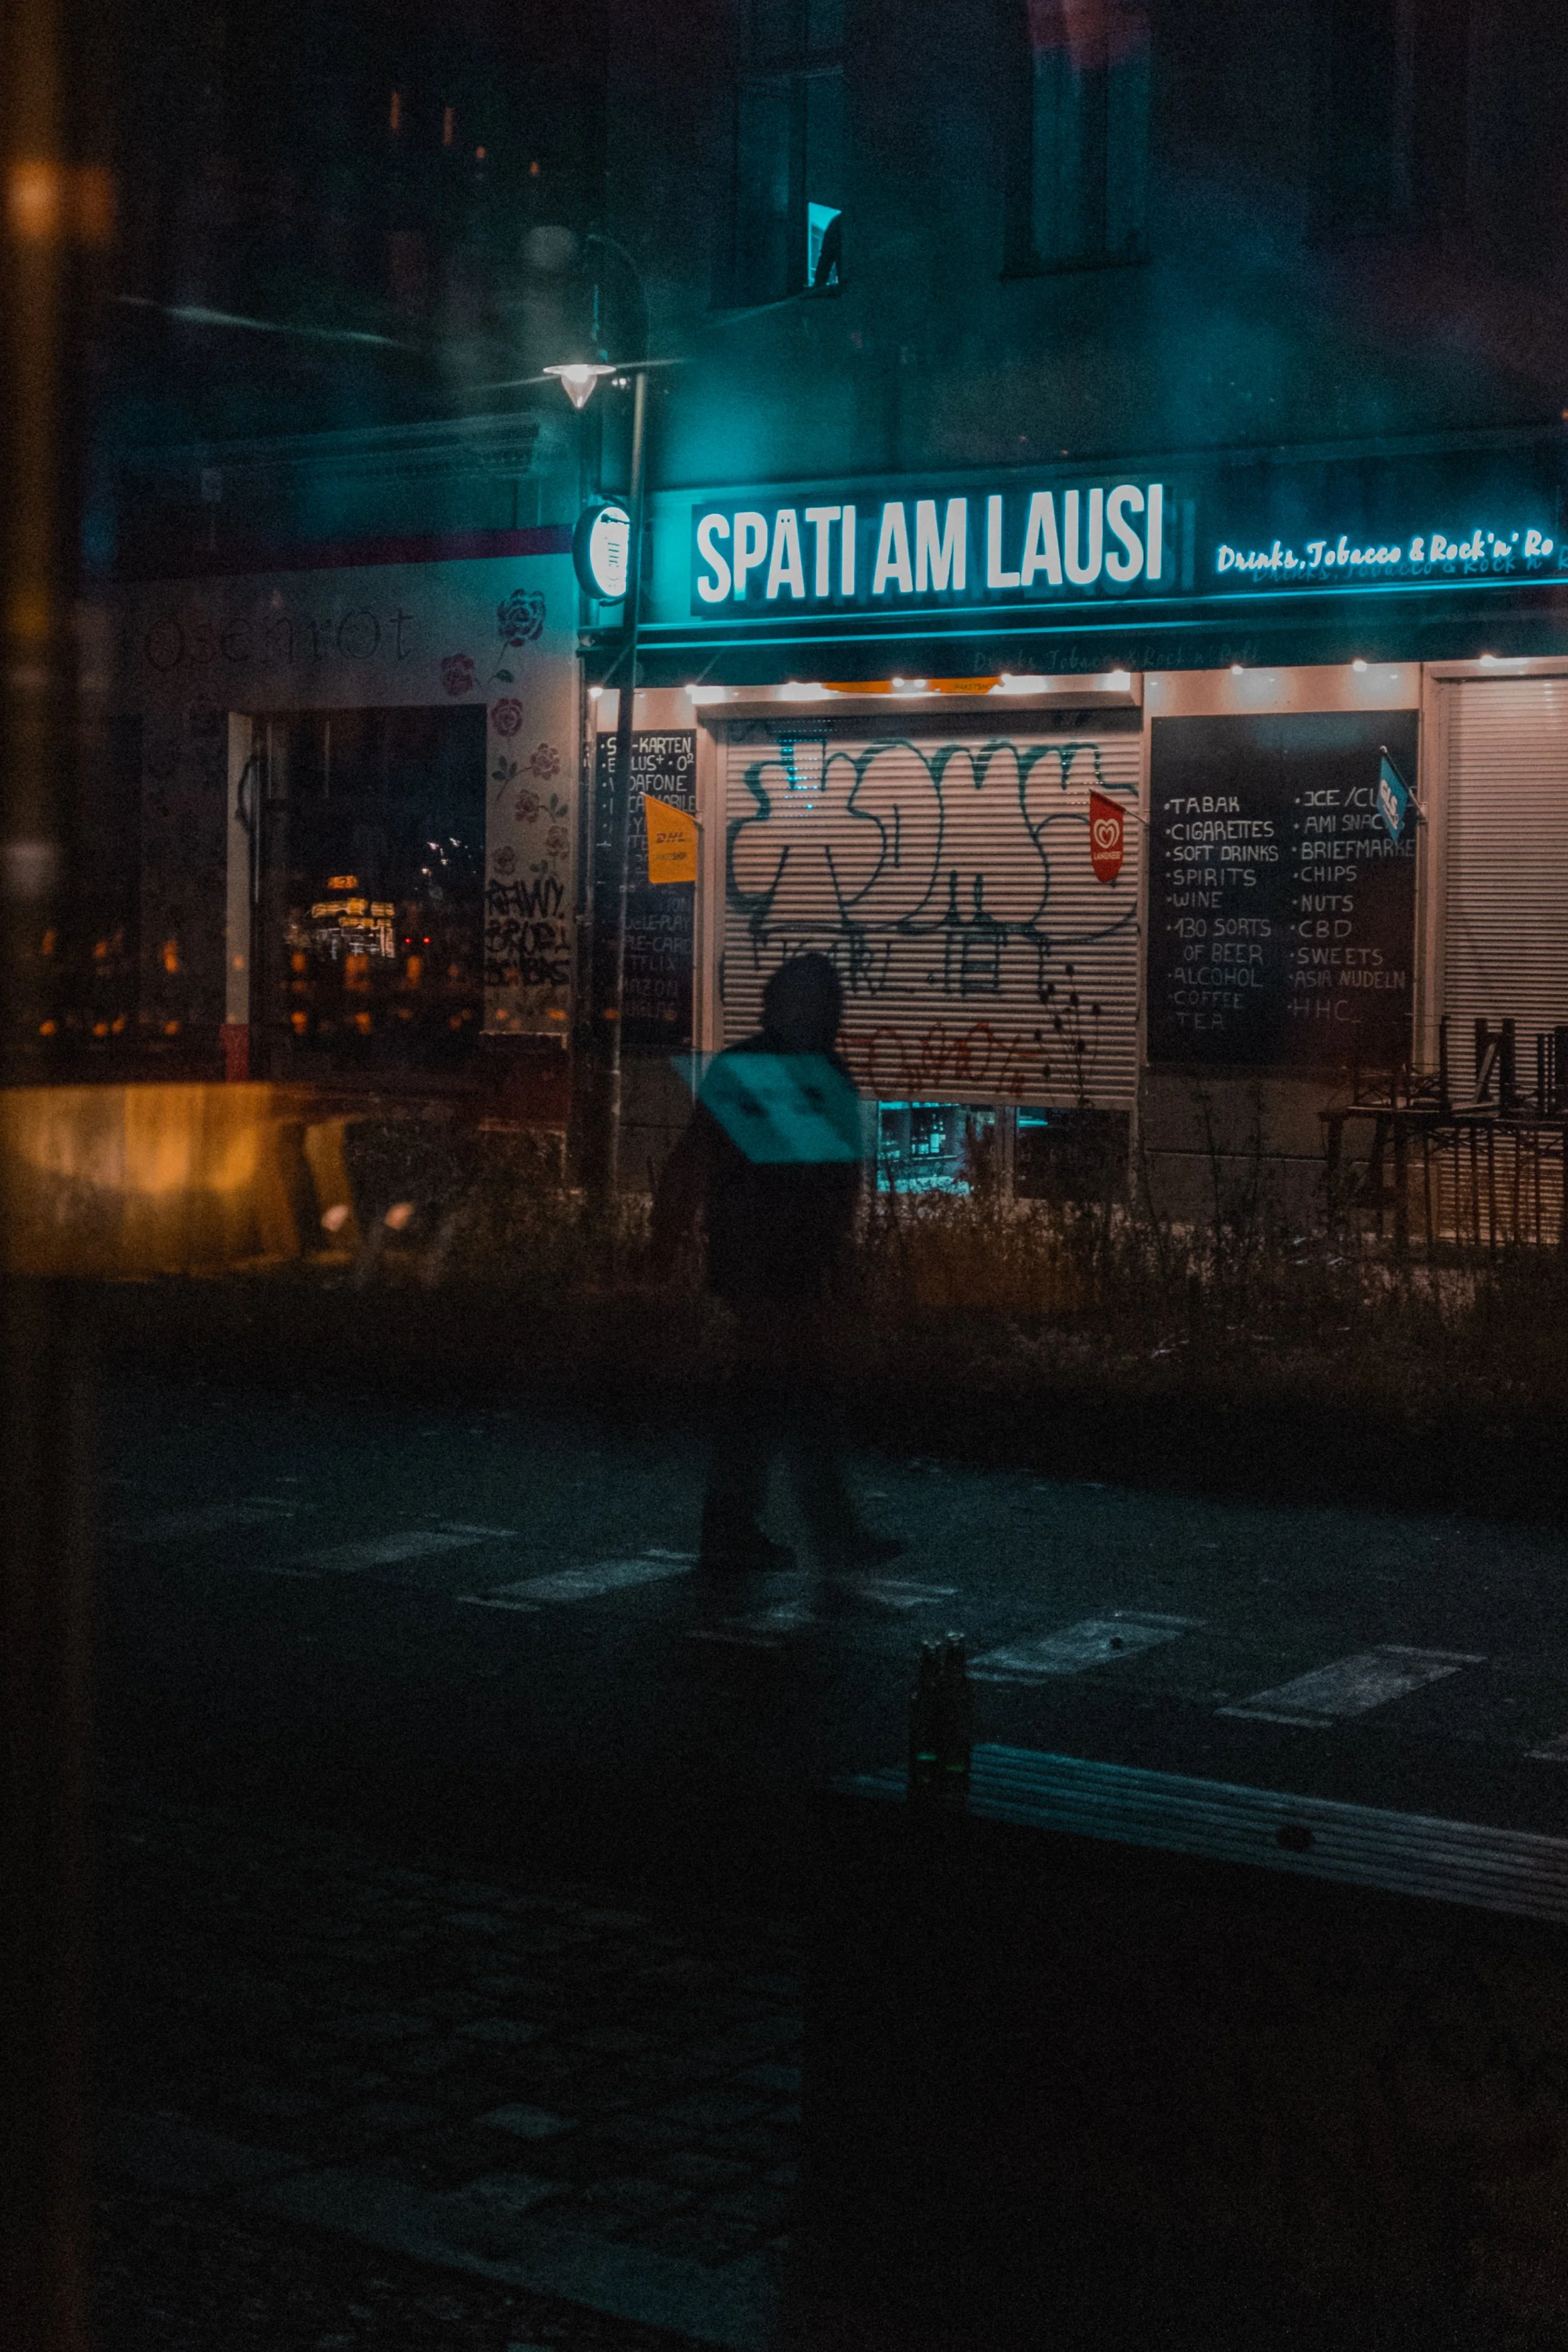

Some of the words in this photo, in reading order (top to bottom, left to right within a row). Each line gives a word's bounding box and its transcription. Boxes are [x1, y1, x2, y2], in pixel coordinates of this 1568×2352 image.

[696, 505, 856, 604] SPÄTI
[872, 497, 967, 594] AM
[987, 483, 1163, 589] LAUSI
[1306, 535, 1402, 568] Tobacco
[1409, 537, 1425, 561] &
[1170, 796, 1240, 815] TABAK
[1172, 820, 1275, 841] CIGARETTES
[1173, 845, 1215, 862] SOFT
[1221, 845, 1279, 862] DRINKS
[1173, 868, 1257, 886] SPIRITS
[1300, 866, 1357, 882] CHIPS
[1173, 891, 1223, 908] WINE
[1301, 894, 1354, 912] NUTS
[1174, 917, 1207, 938] 130
[1213, 918, 1272, 937] SORTS
[1298, 919, 1352, 938] CBD
[1184, 945, 1205, 961] OF
[1211, 943, 1263, 965] BEER
[1297, 947, 1384, 966] SWEETS
[1174, 967, 1264, 988] ALCOHOL
[1294, 970, 1333, 988] ASIA
[1173, 990, 1245, 1010] COFFEE
[1175, 1012, 1224, 1030] TEA
